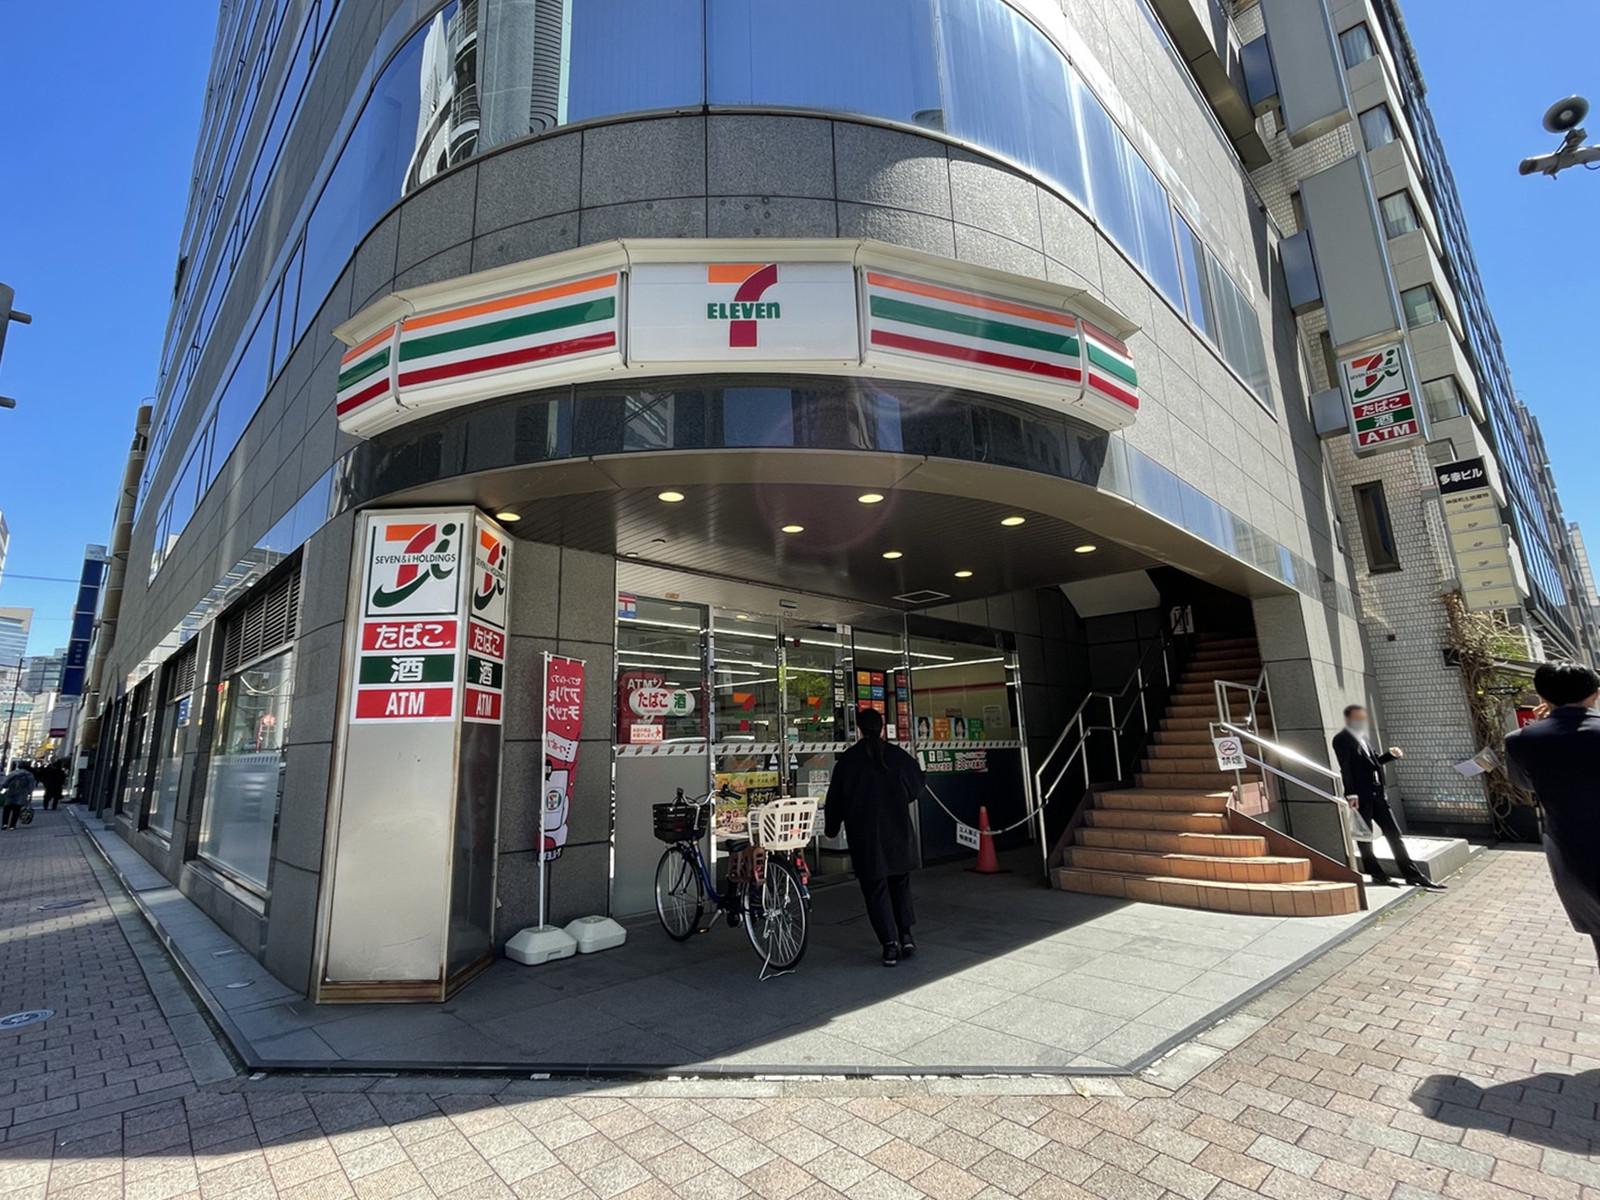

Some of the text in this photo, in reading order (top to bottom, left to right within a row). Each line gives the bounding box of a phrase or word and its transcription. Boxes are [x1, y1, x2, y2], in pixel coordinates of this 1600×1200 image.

[1361, 397, 1402, 416] たばこ
[1374, 412, 1394, 428] 酒
[1366, 423, 1411, 444] ATM
[1439, 467, 1483, 485] 多幸ビル
[412, 553, 456, 563] HOLDINGS
[374, 622, 444, 649] たばこ
[473, 627, 501, 656] たばこ
[390, 657, 425, 683] 酒
[479, 660, 493, 686] 酒
[385, 691, 425, 715] ATM
[476, 693, 492, 716] ATM
[638, 692, 668, 708] たばこ
[674, 693, 687, 709] 酒
